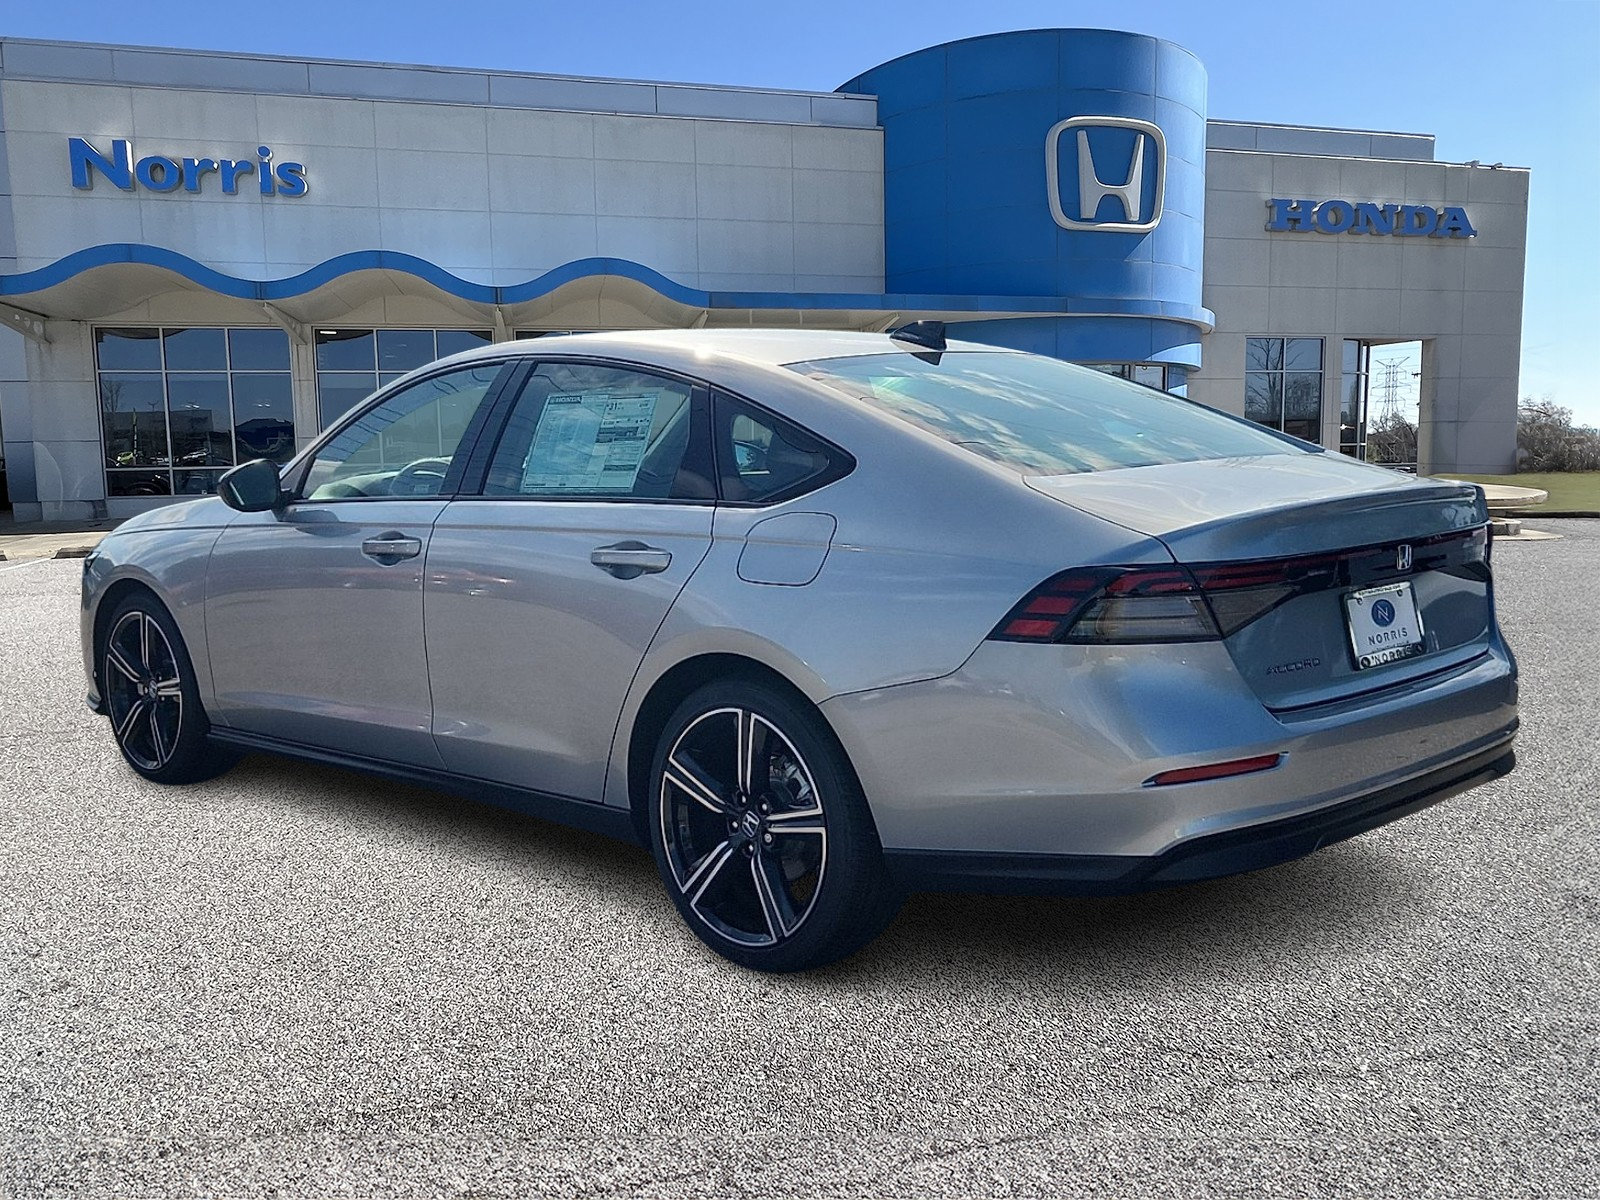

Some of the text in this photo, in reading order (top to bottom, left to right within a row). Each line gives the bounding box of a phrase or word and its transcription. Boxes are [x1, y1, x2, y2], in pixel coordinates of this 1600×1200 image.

[68, 137, 308, 197] Norris
[1265, 198, 1478, 239] HONDA
[1368, 627, 1408, 646] NORRIS
[1372, 645, 1413, 665] NORRIS
[1266, 657, 1321, 675] ACCORD
